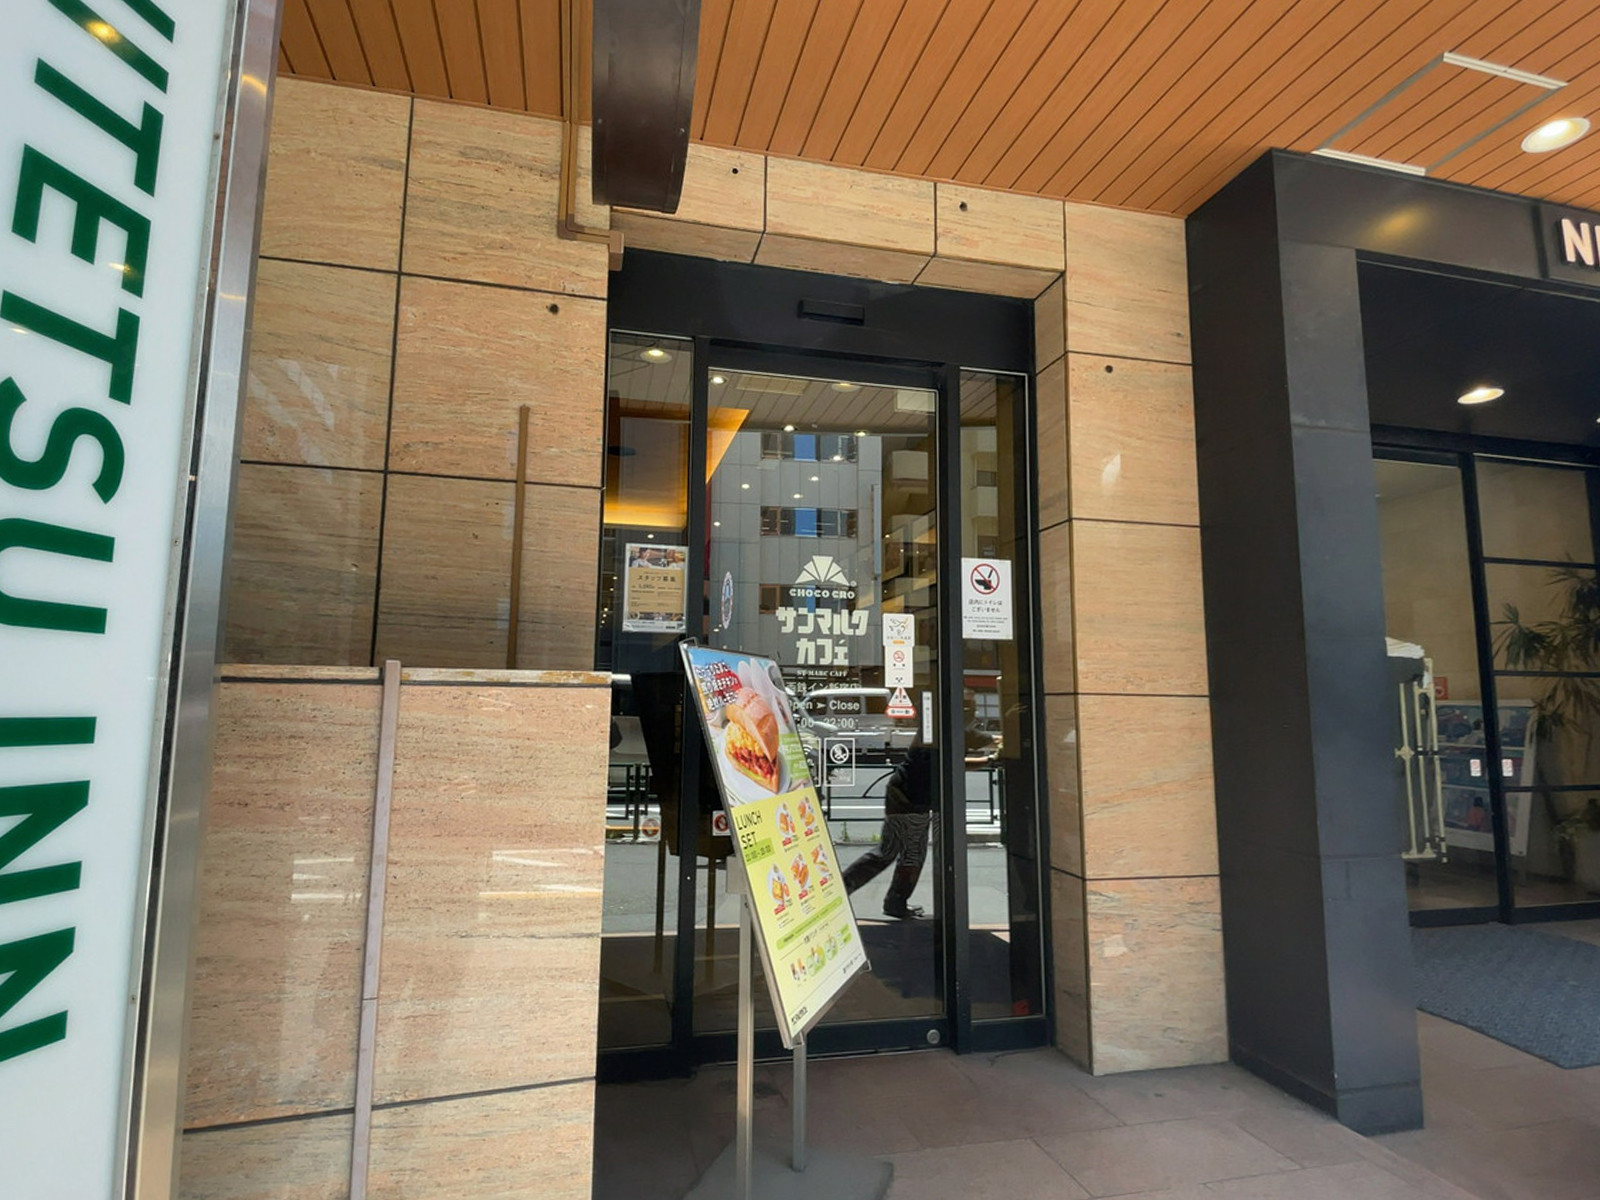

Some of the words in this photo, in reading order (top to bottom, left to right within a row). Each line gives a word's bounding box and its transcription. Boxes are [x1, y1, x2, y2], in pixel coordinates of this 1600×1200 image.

[789, 588, 830, 598] CHOCO
[831, 590, 855, 599] CRO
[776, 606, 869, 636] サンマルク
[796, 637, 849, 666] カフェ
[829, 700, 860, 710] Close
[735, 810, 763, 831] LUNCH
[741, 831, 757, 850] SET
[0, 715, 97, 1063] INN
